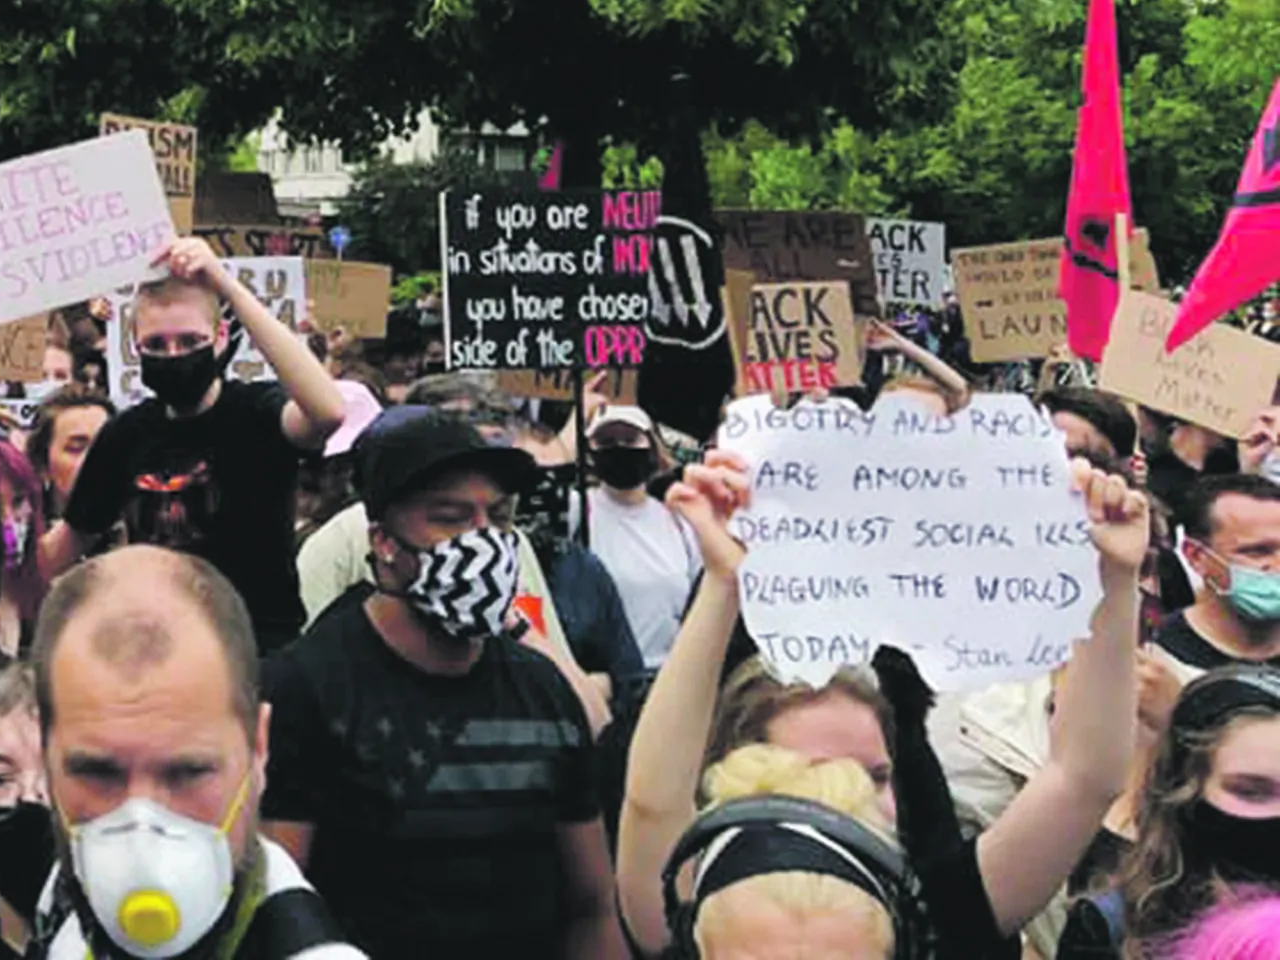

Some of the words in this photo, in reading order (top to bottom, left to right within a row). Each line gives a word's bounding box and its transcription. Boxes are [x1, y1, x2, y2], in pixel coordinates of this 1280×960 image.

[496, 204, 537, 240] you
[546, 204, 590, 230] are
[448, 245, 471, 275] in
[479, 237, 578, 276] situations
[583, 234, 606, 274] of
[466, 297, 507, 334] you
[511, 284, 564, 321] have
[453, 334, 498, 367] side
[506, 327, 530, 367] of
[537, 326, 575, 368] the
[725, 401, 876, 438] BIGOTRY
[891, 410, 958, 436] AND
[755, 460, 821, 492] ARE
[853, 462, 968, 491] AMONG
[997, 465, 1056, 488] THE
[915, 519, 1014, 548] SOCIAL
[742, 570, 872, 606] PLAGUING
[888, 573, 949, 600] THE
[976, 572, 1083, 609] WORLD
[758, 632, 872, 664] TODAY
[943, 636, 1014, 674] Stan
